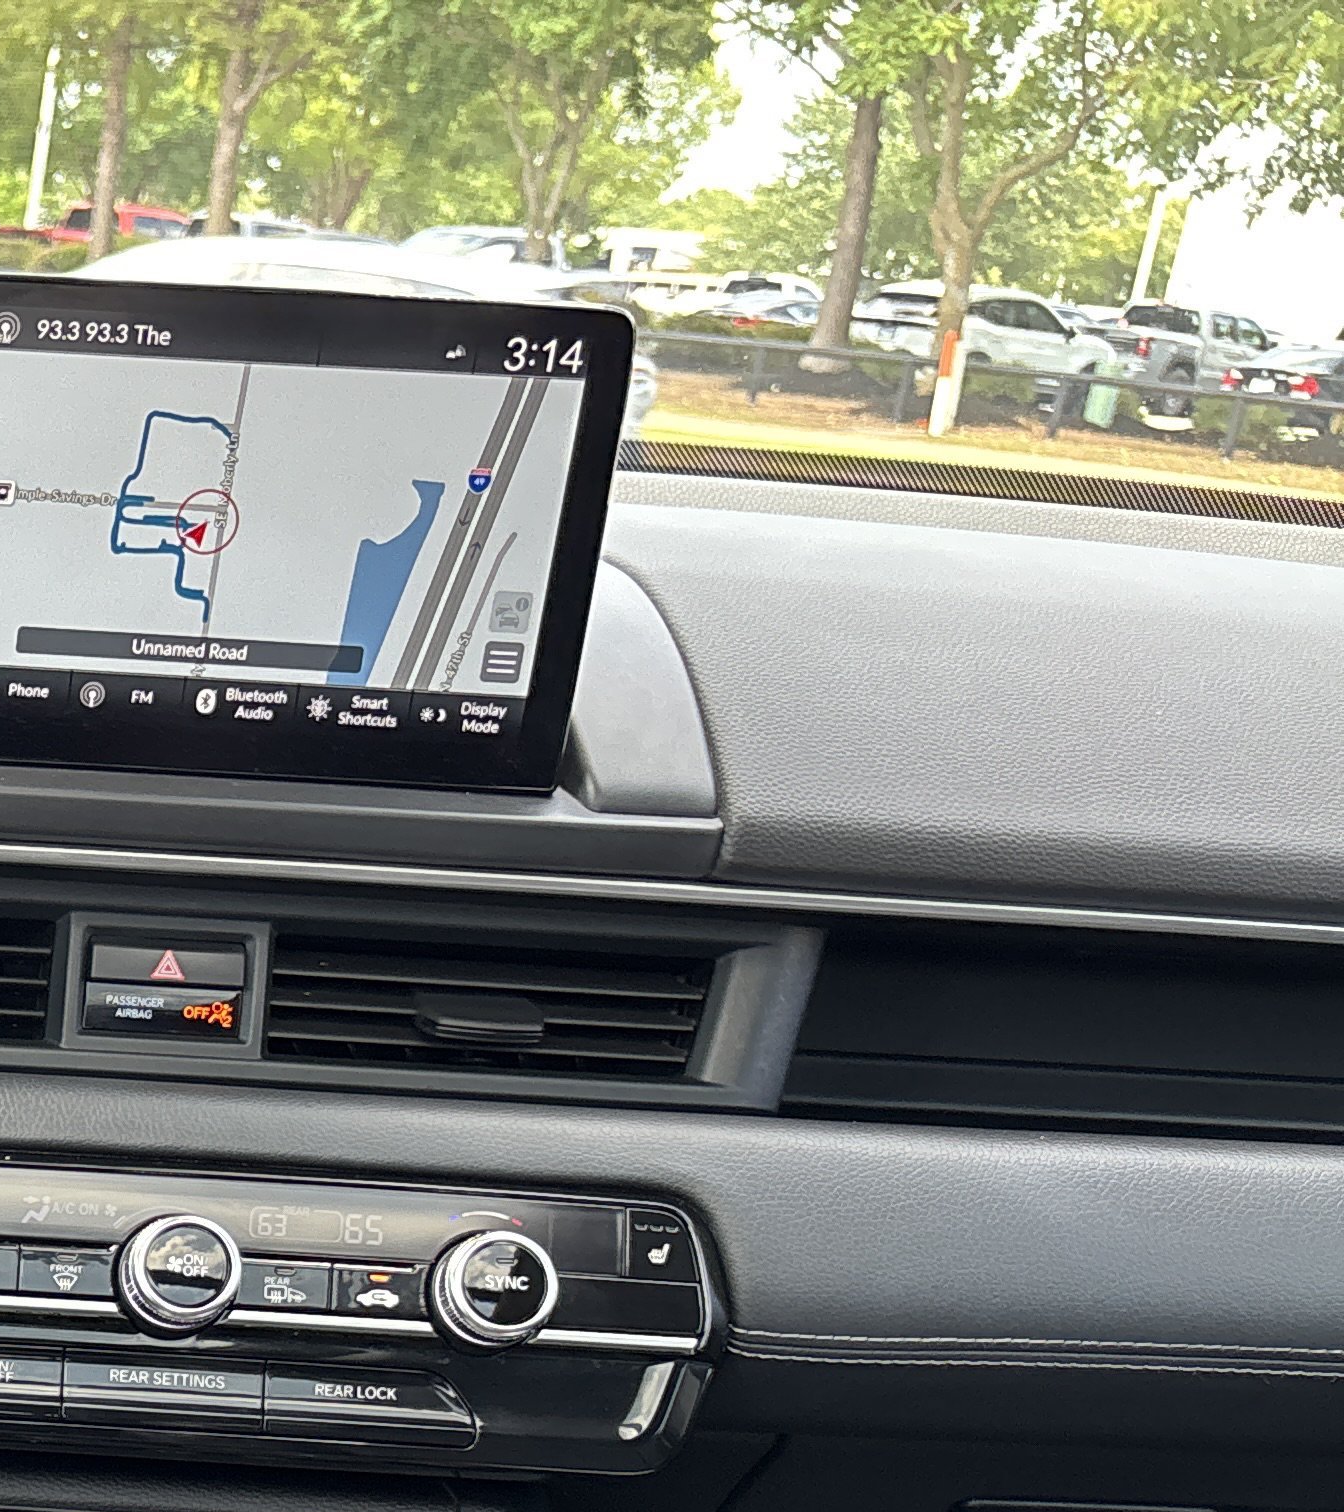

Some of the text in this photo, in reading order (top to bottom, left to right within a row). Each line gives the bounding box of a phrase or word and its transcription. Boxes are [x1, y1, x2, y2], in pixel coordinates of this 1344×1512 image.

[37, 320, 172, 346] 93.3 93.3 The
[504, 339, 584, 374] 3:14
[52, 489, 95, 507] Savings
[101, 493, 117, 506] Dr
[132, 638, 248, 661] Unnamed Road
[8, 682, 49, 699] Phone
[131, 689, 153, 704] FM
[225, 687, 287, 706] Bluetooth
[351, 695, 388, 711] Smart
[460, 702, 507, 720] Display
[234, 706, 273, 722] Audio
[338, 711, 397, 728] Shortcuts
[461, 720, 499, 734] Mode
[105, 994, 164, 1008] PASSENGER
[115, 1008, 153, 1020] AIRBAG
[183, 1005, 210, 1020] OFF
[51, 1202, 99, 1216] A/C ON
[258, 1213, 287, 1237] 63
[344, 1214, 383, 1246] 65
[49, 1263, 83, 1275] FRONT
[182, 1265, 209, 1278] OFF
[264, 1276, 290, 1286] REAR
[484, 1274, 529, 1291] SYNC
[109, 1369, 225, 1389] REAR SETTINGS
[314, 1383, 397, 1400] REAR LOCK
